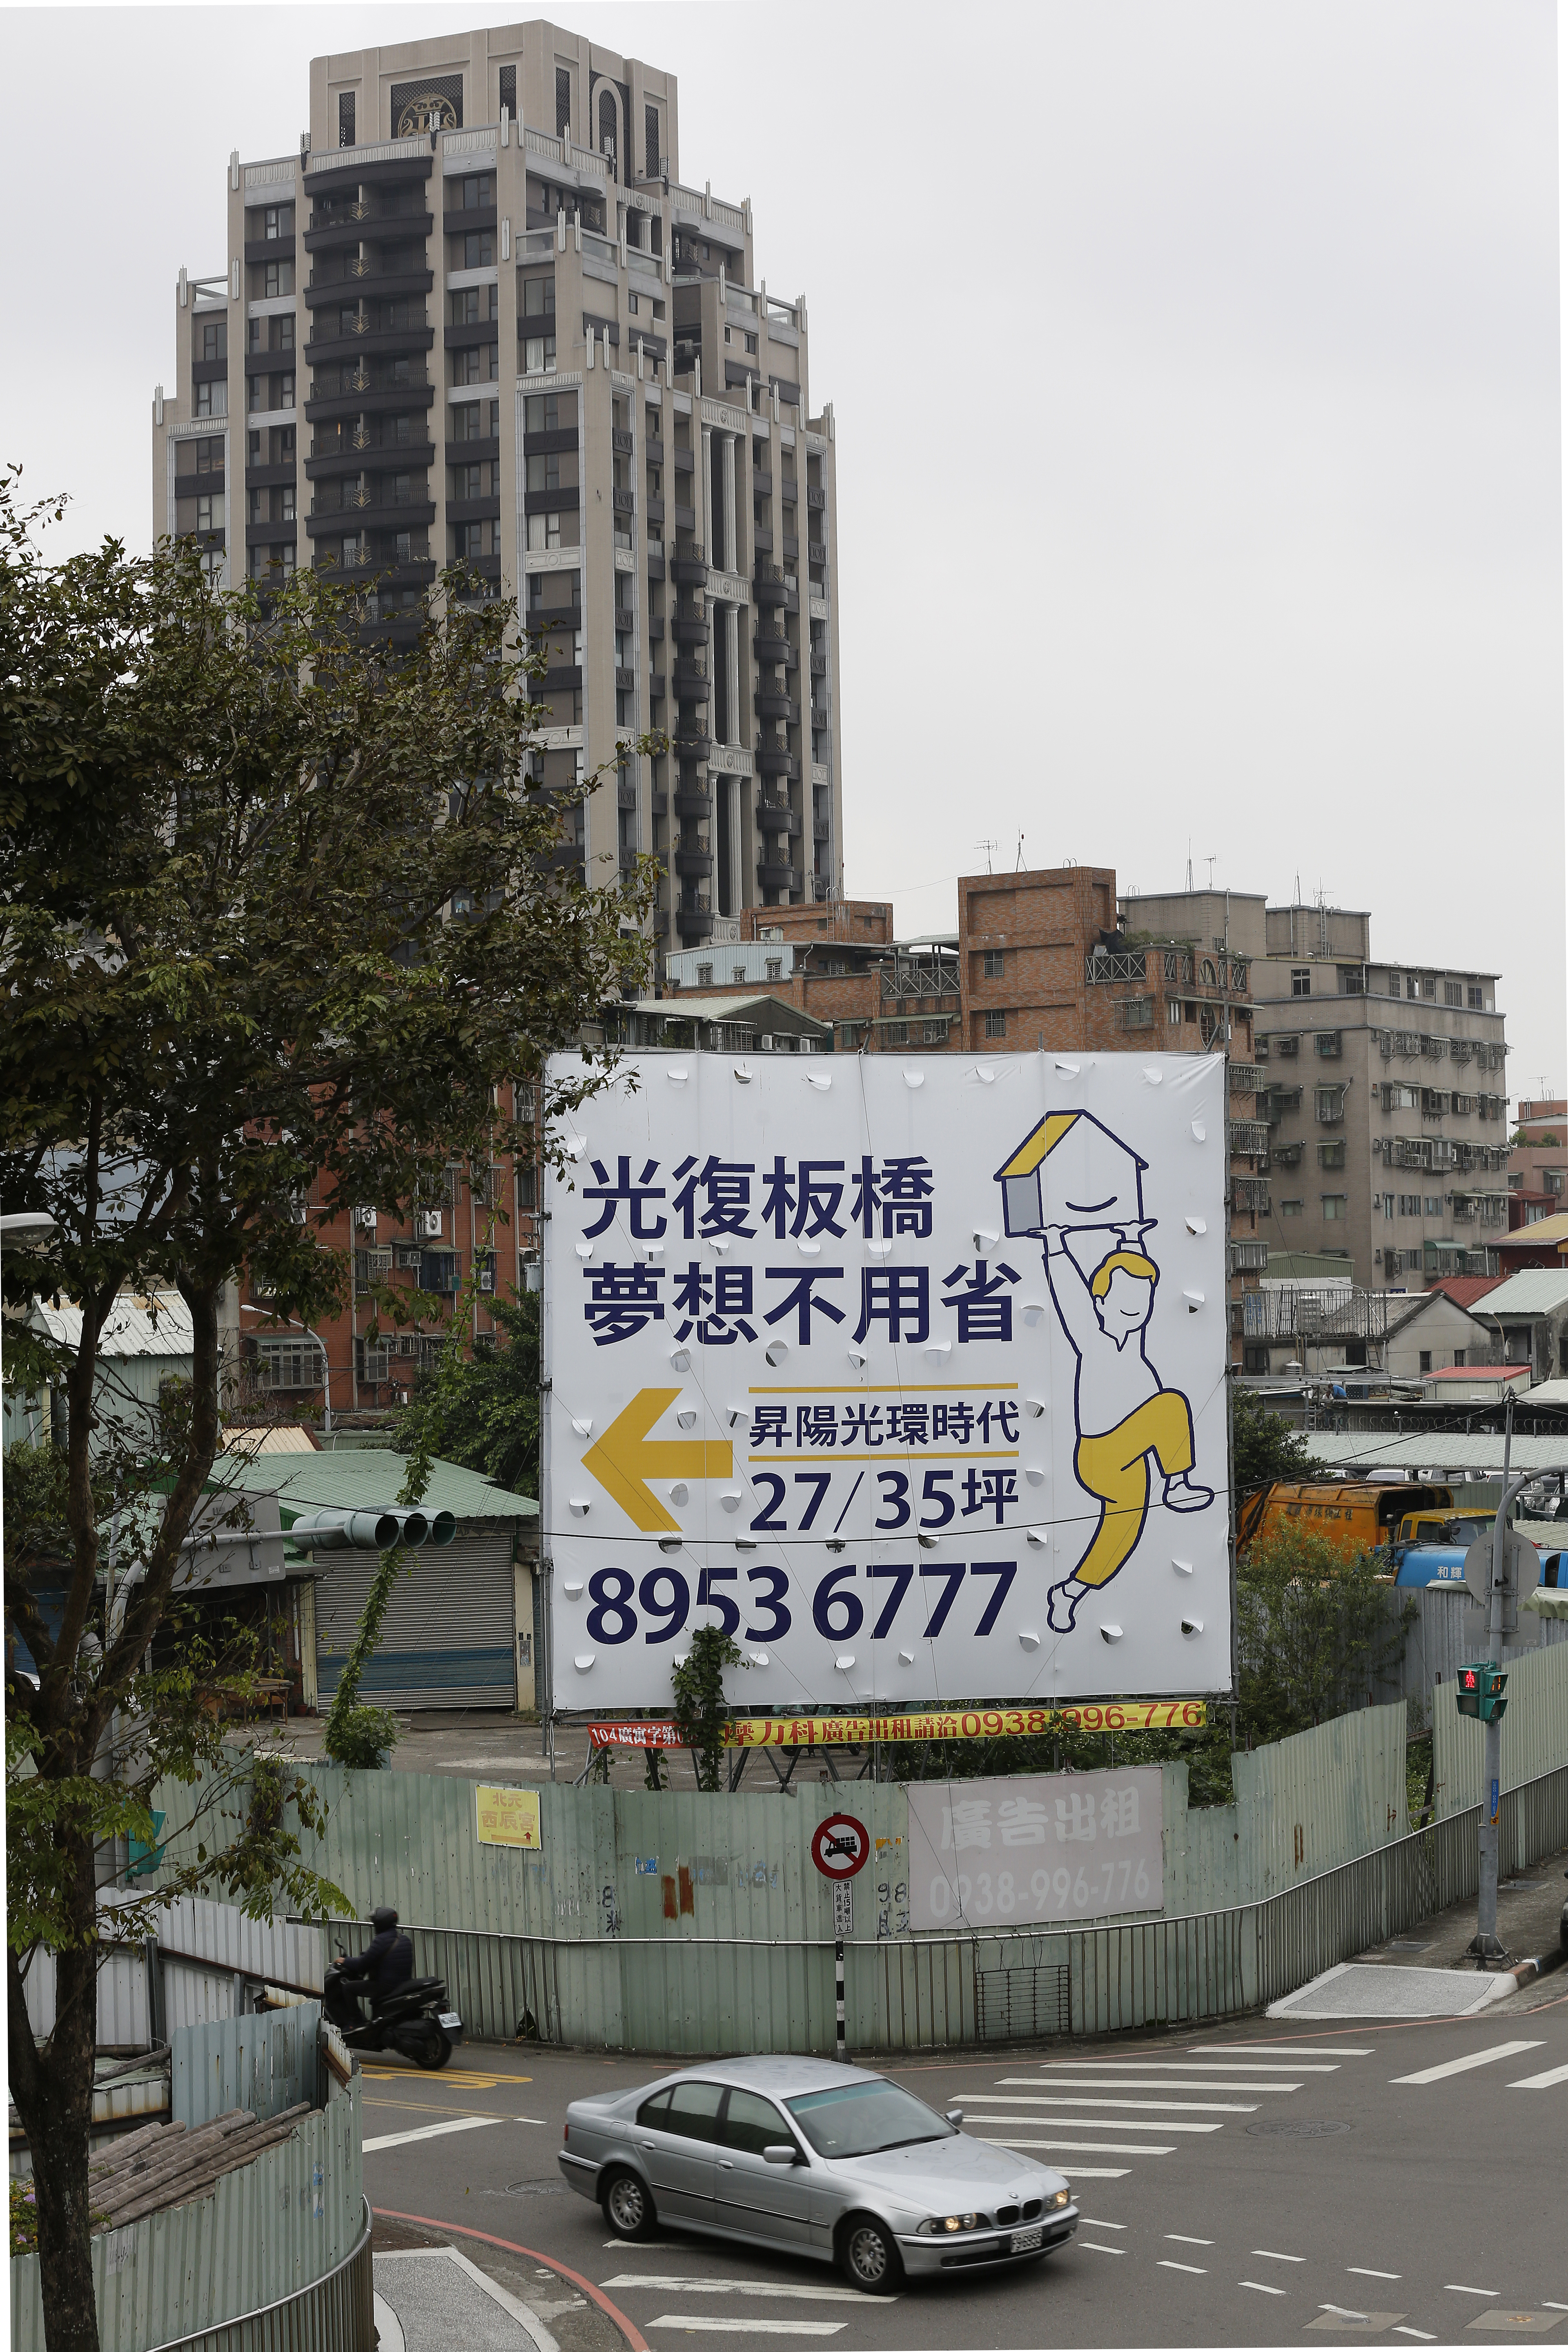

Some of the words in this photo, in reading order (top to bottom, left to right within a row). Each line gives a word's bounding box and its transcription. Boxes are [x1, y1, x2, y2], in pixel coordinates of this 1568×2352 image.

[583, 1156, 933, 1238] 光復板橋
[583, 1260, 1021, 1345] 夢想不用省
[750, 1401, 1019, 1446] 昇陽光環時代
[751, 1469, 1018, 1532] 27/35坪
[587, 1567, 791, 1644] 8953
[813, 1562, 1017, 1640] 6777
[481, 1811, 535, 1831] 西辰宮
[492, 1792, 522, 1808] 北元
[940, 1786, 1142, 1851] 廣告出租
[929, 1858, 1150, 1918] 0938-996-776
